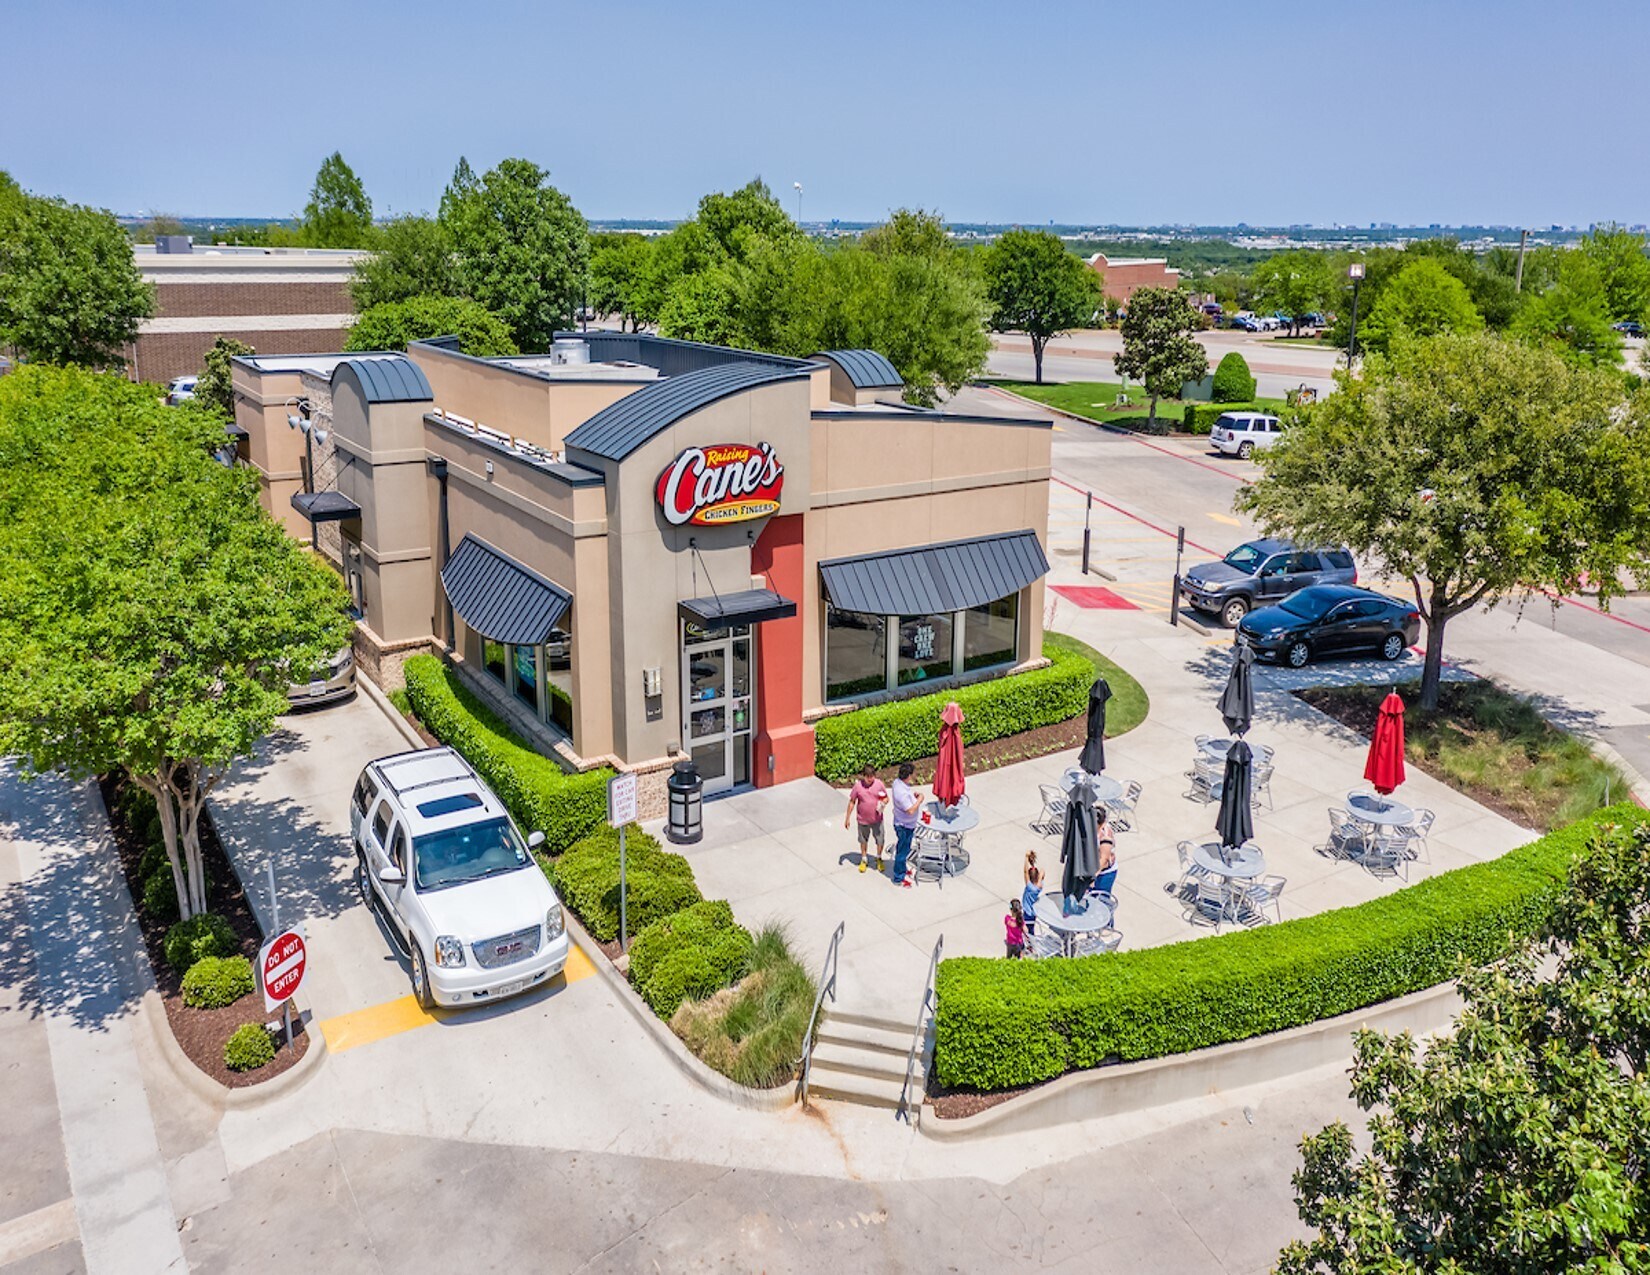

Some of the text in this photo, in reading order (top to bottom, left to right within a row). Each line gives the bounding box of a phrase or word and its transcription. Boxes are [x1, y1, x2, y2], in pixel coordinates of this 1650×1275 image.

[706, 448, 749, 466] Raising
[664, 442, 784, 525] Cane's
[268, 938, 299, 968] DO NOT
[274, 968, 299, 993] ENTER
